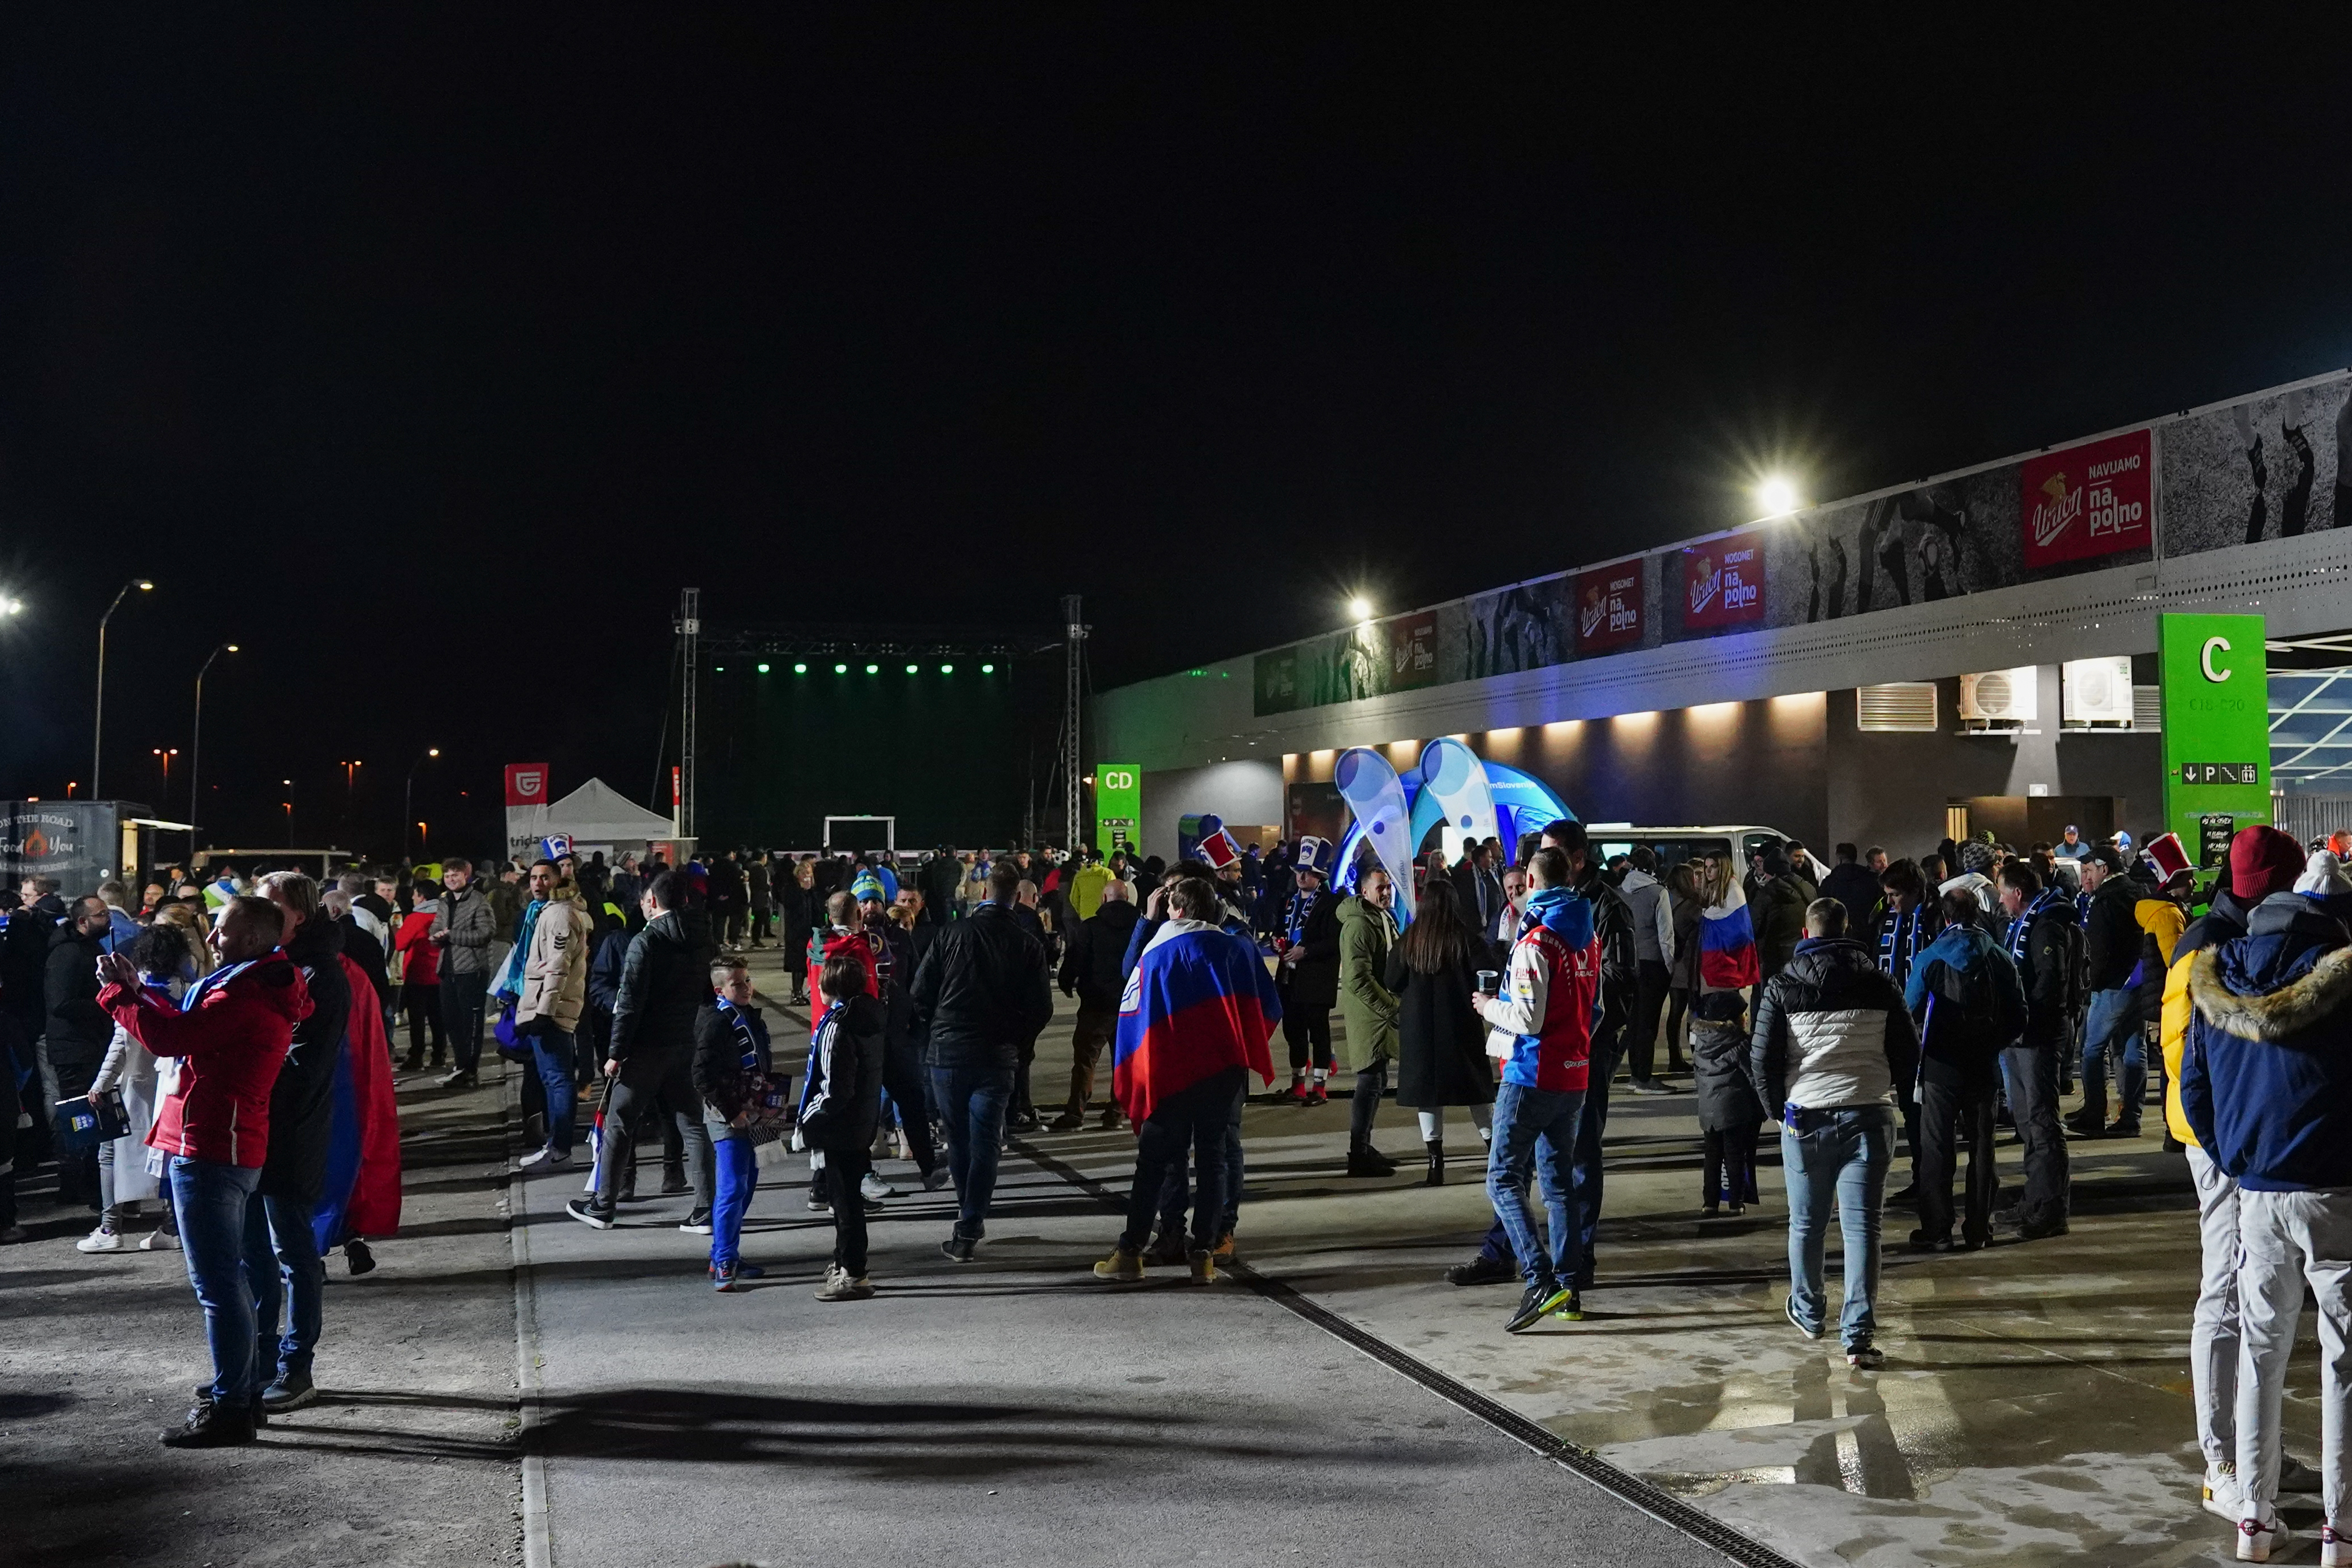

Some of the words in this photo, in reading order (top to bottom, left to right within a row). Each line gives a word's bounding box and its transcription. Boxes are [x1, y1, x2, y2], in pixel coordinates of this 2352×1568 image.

[2088, 454, 2141, 480] NAVIJAMO
[2090, 487, 2112, 509] na
[2032, 486, 2083, 542] Union
[2090, 496, 2142, 537] polno
[1725, 549, 1754, 564] NOGOMET
[1725, 572, 1739, 587] na
[1725, 579, 1757, 609] polno
[1610, 598, 1622, 613] na
[1610, 604, 1637, 633] polno
[2201, 636, 2232, 683] C
[1105, 771, 1133, 790] CD
[2206, 766, 2216, 781] P
[14, 814, 39, 824] THE
[41, 814, 74, 828] ROAD
[49, 835, 74, 856] You
[1516, 968, 1538, 978] FIAMM
